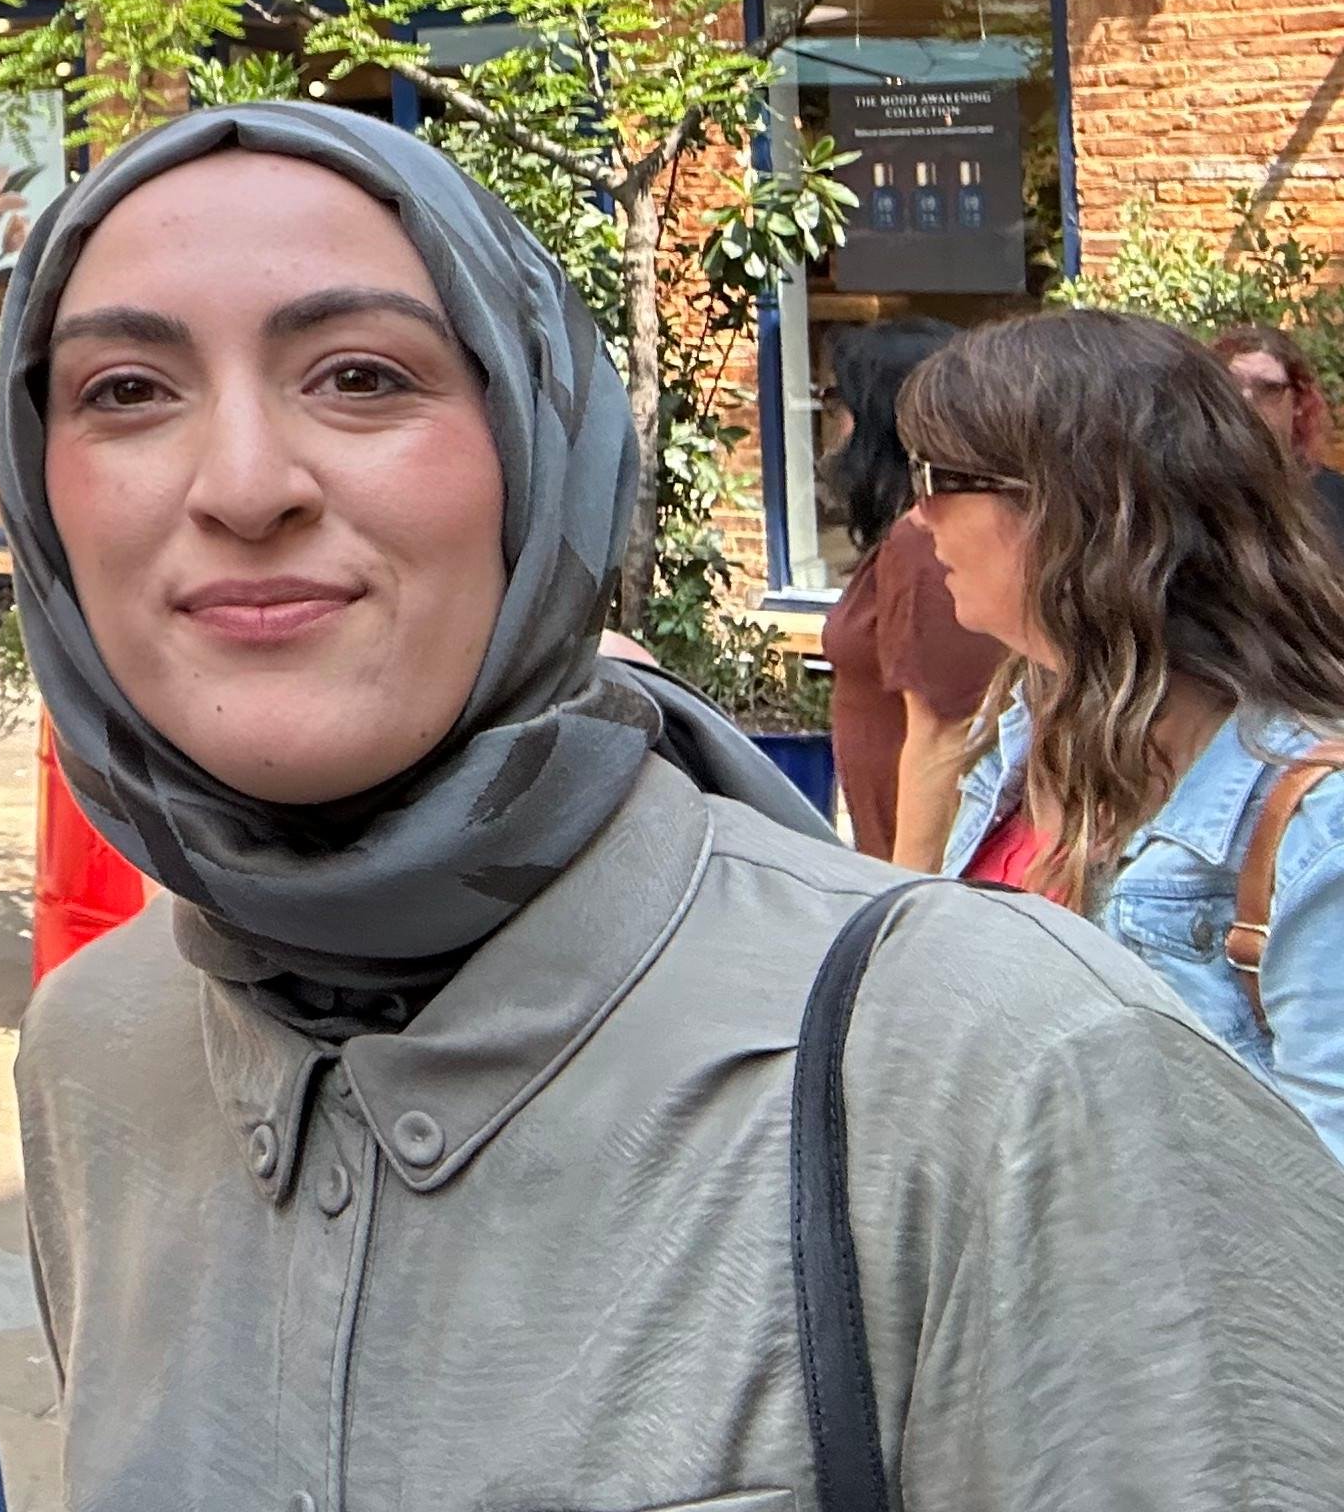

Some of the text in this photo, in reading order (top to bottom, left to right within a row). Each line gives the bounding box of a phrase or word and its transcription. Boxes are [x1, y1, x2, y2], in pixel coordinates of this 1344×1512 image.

[855, 90, 992, 108] THE MOOD AWAKENING
[884, 105, 961, 118] COLLECTION
